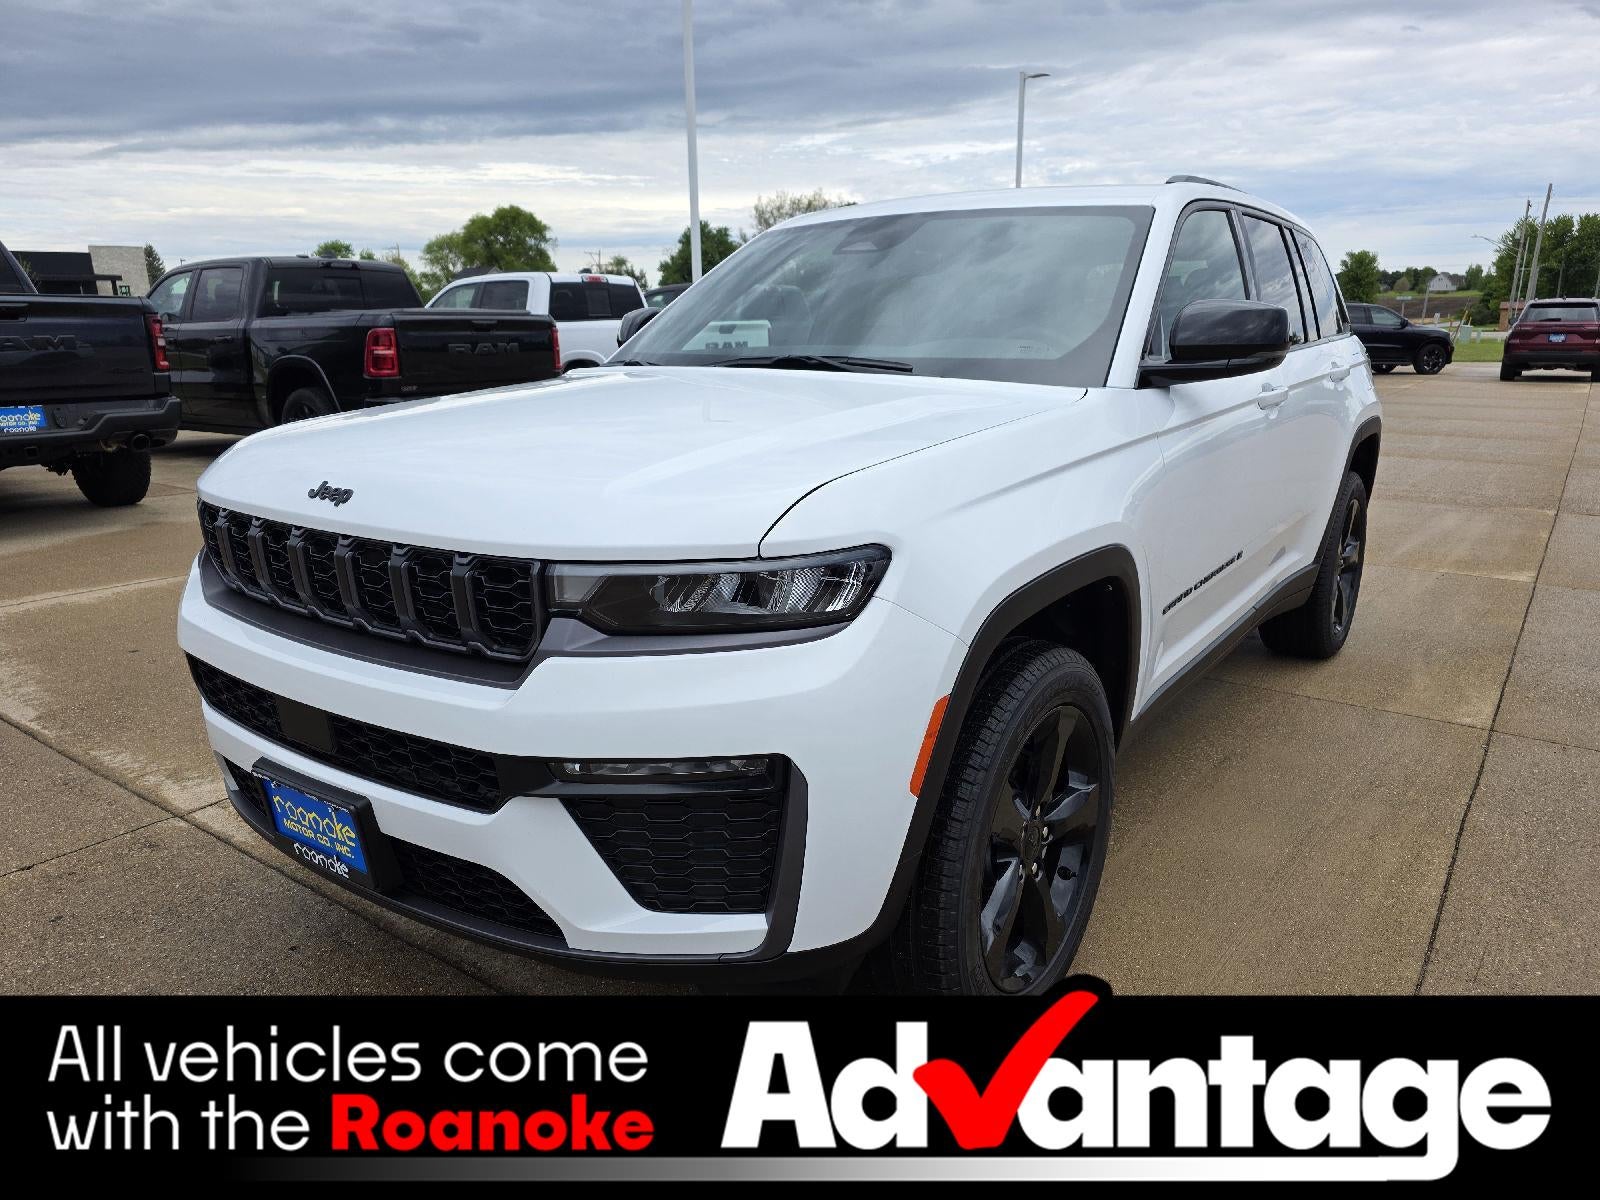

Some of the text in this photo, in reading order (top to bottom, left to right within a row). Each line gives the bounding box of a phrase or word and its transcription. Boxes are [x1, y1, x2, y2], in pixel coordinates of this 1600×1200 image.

[0, 335, 76, 352] AM
[448, 342, 520, 355] RAM
[0, 410, 41, 422] oanoke
[308, 480, 354, 507] Jeep
[273, 795, 356, 847] roanoke
[283, 818, 355, 859] MOTOR CO. INC.
[293, 842, 350, 878] roanoke
